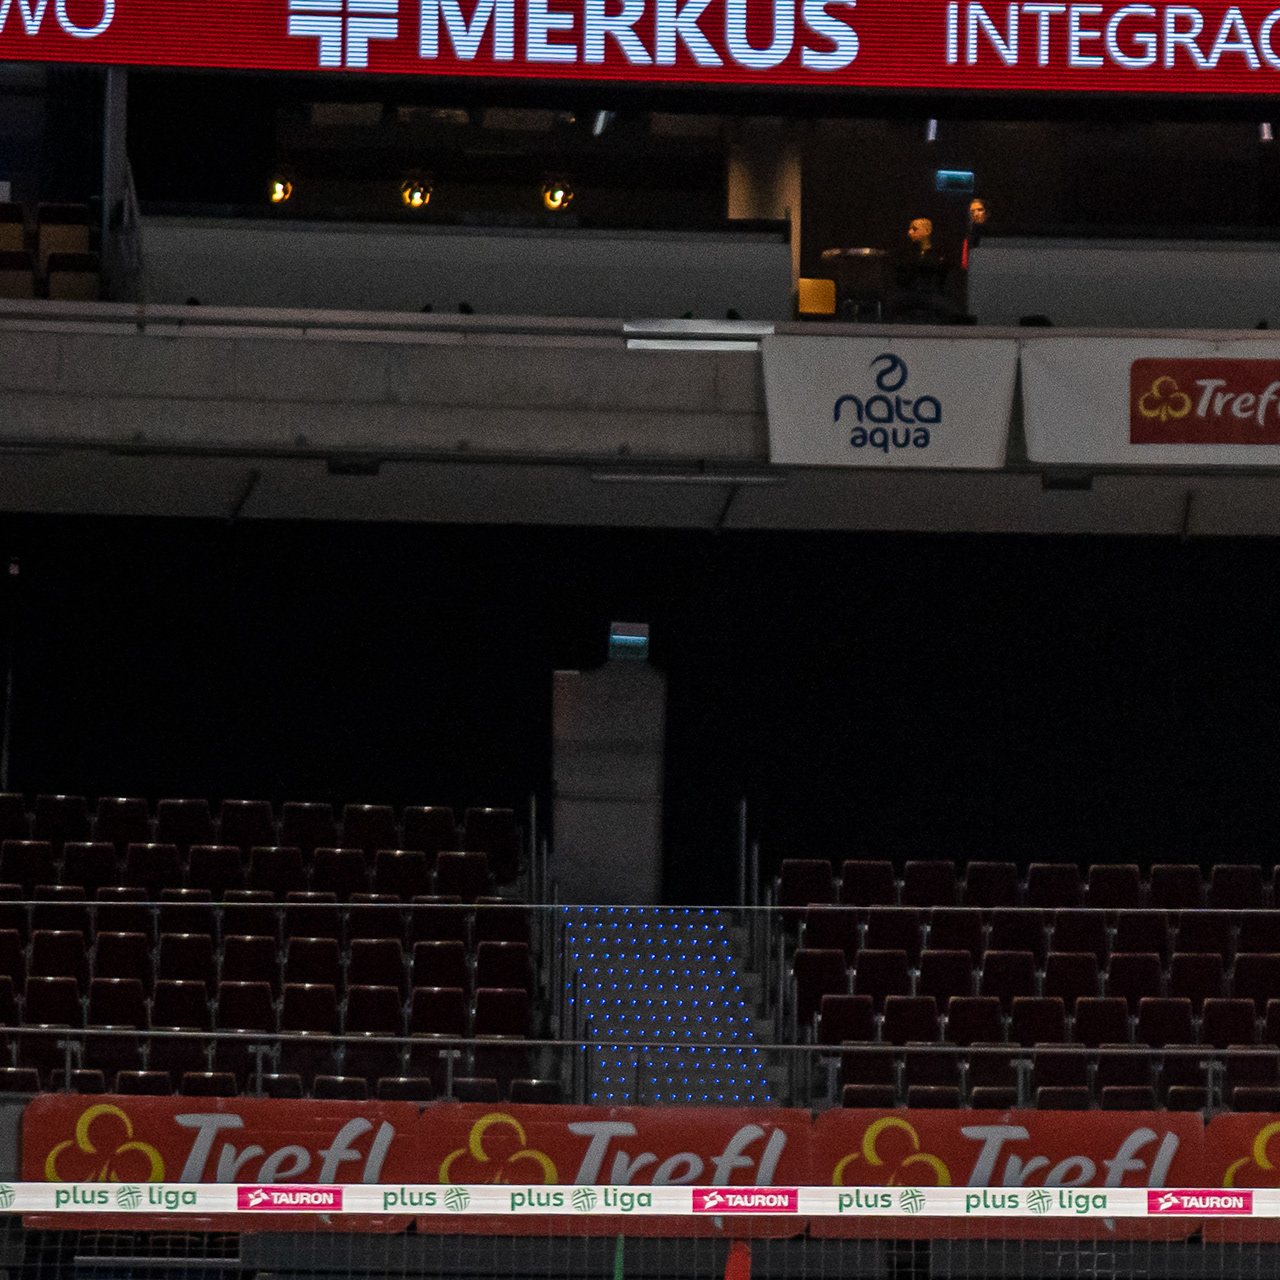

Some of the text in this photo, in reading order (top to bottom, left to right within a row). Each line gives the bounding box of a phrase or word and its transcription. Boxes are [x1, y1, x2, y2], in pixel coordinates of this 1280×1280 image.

[418, 0, 861, 71] MERKUS
[834, 394, 942, 424] nata
[850, 427, 932, 453] aqua
[175, 1113, 396, 1222] Trefl
[568, 1121, 789, 1229] Trefl
[961, 1126, 1180, 1231] Trefl
[55, 1185, 197, 1210] plus liga
[271, 1192, 334, 1206] TAURON
[383, 1188, 437, 1211] plus
[510, 1187, 652, 1211] plus liga
[725, 1194, 789, 1207] TAURON
[838, 1190, 892, 1213] plus
[965, 1189, 1107, 1213] plus liga
[1180, 1196, 1244, 1208] TAURON
